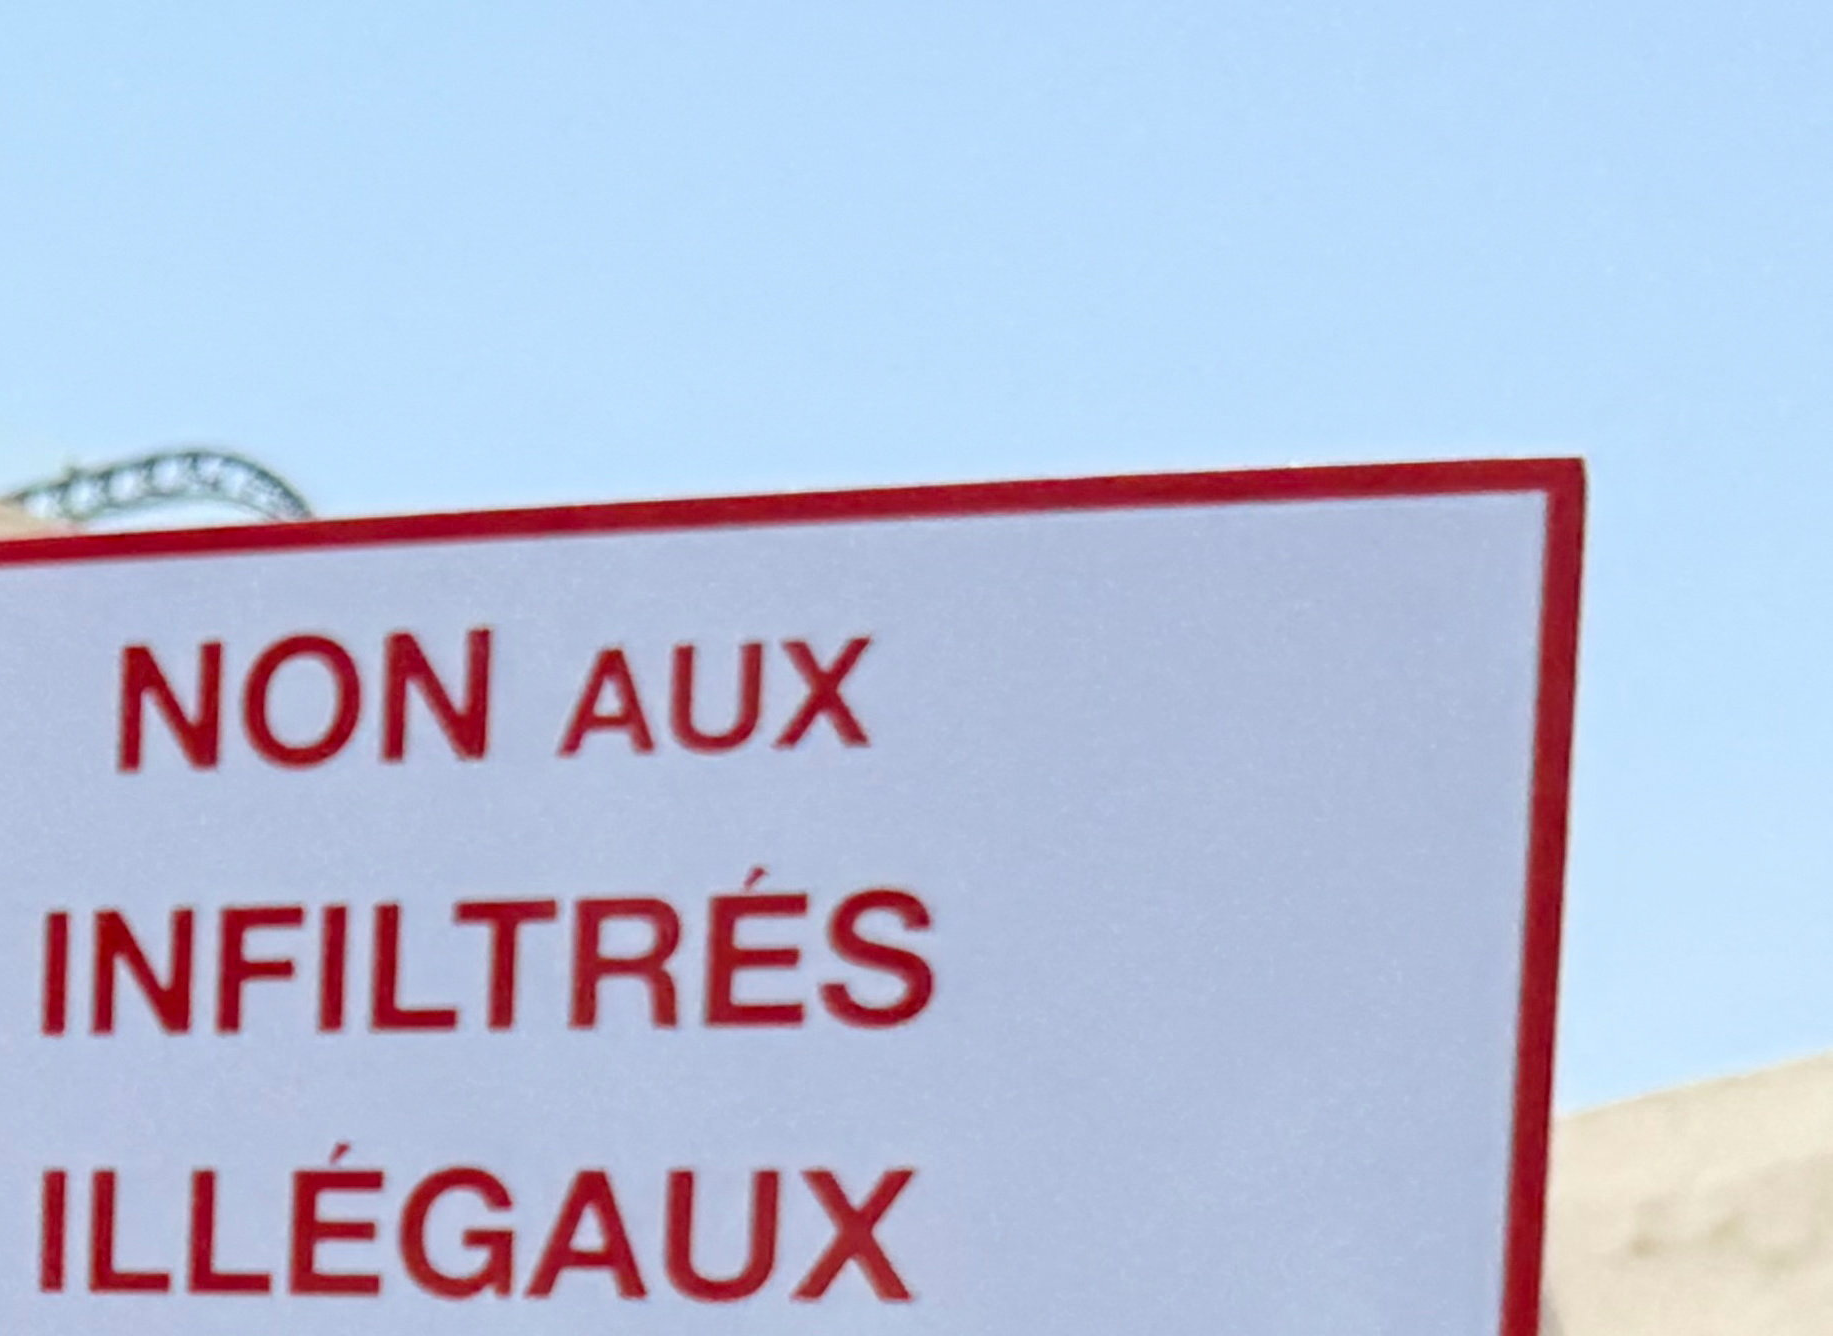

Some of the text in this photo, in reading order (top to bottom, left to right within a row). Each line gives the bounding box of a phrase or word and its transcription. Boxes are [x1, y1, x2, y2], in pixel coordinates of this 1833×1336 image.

[119, 628, 870, 772] NON AUX
[42, 866, 935, 1037] INFILTRÉS
[40, 1141, 914, 1303] ILLÉGAUX
